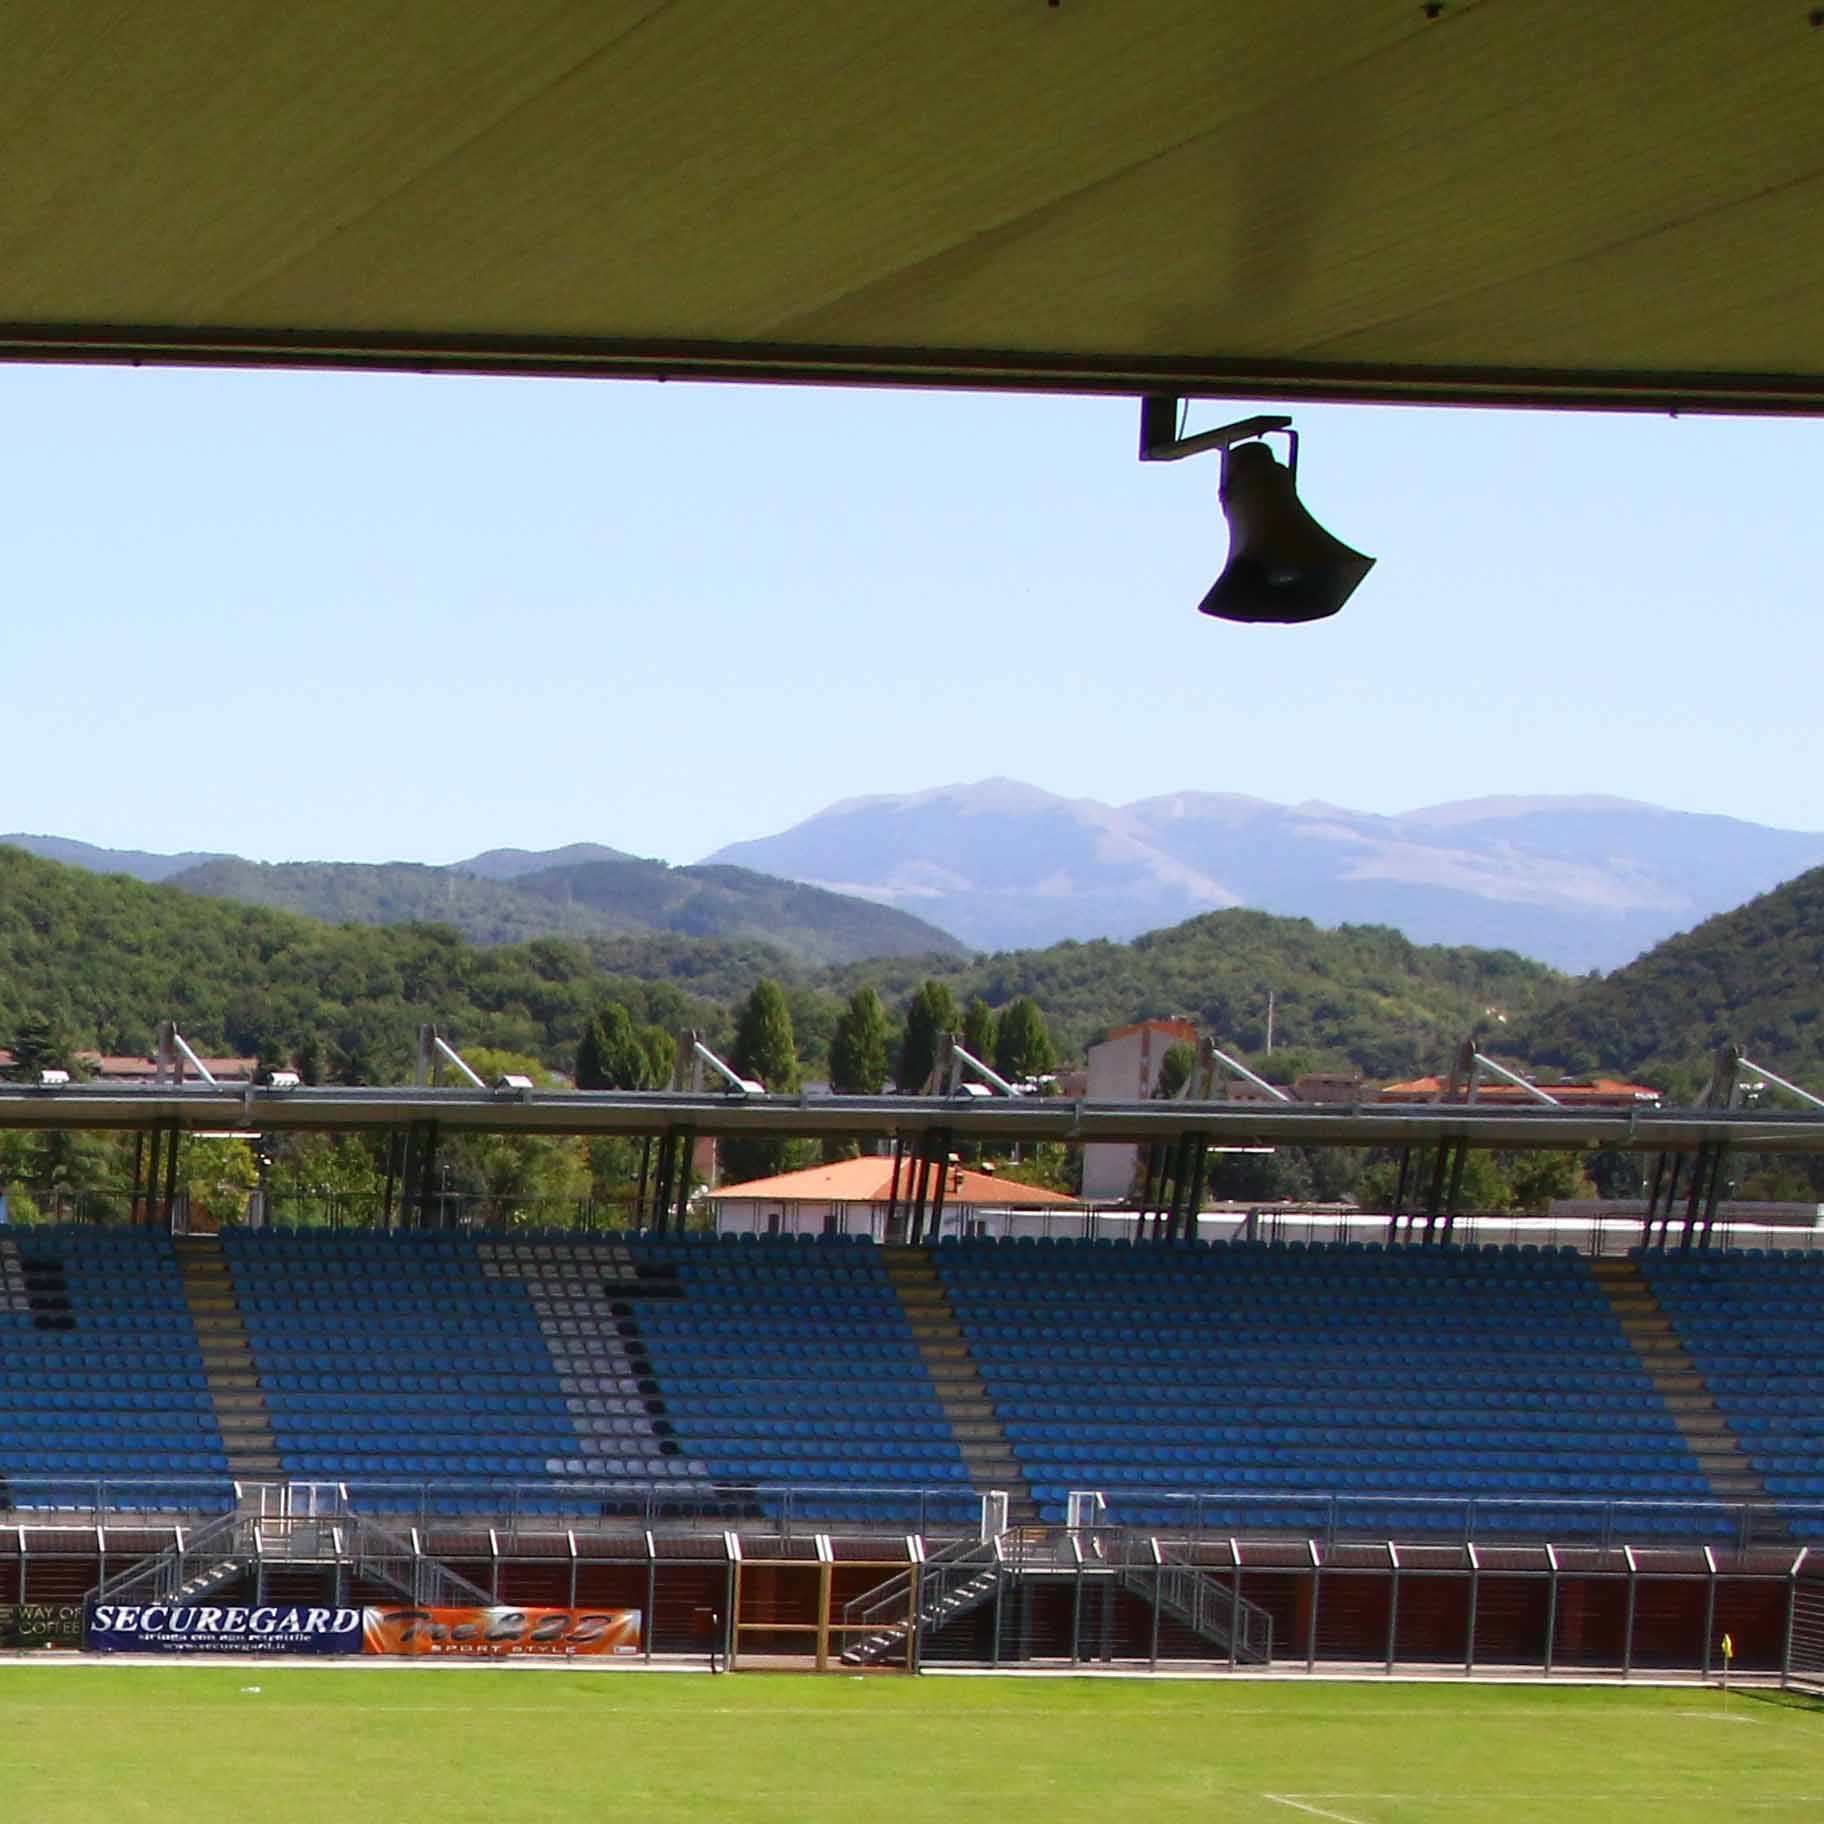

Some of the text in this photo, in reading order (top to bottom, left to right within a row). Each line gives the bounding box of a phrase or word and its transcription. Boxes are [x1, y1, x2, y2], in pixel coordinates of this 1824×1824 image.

[18, 1607, 81, 1620] WAY OF
[90, 1606, 360, 1633] SECUREGARD
[190, 1633, 216, 1641] con
[431, 1644, 577, 1654] SPORT STYLE
